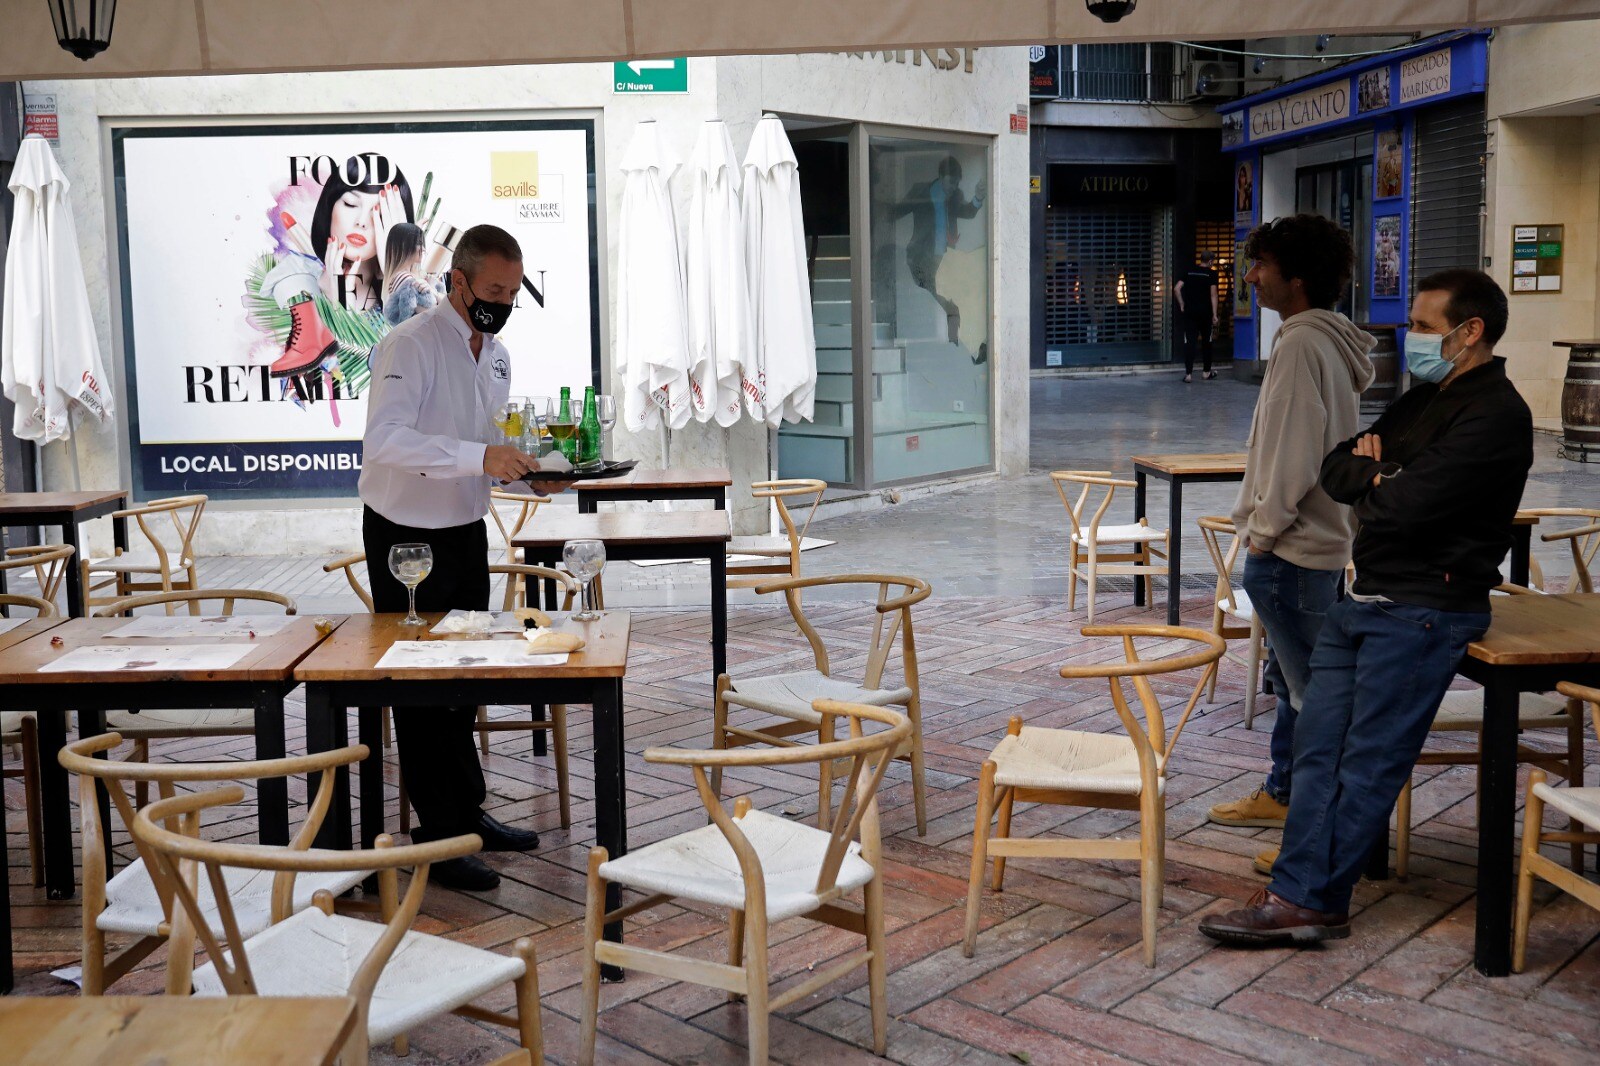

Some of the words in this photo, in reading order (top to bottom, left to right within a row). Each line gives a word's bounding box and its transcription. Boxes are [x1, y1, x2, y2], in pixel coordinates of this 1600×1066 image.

[1402, 51, 1449, 78] PESCADOS
[627, 82, 654, 91] Nueva
[1402, 75, 1449, 99] MARISCOS
[287, 154, 398, 187] FOOD
[494, 182, 537, 197] savills
[520, 203, 560, 211] AGUIRRE
[161, 455, 237, 474] LOCAL
[243, 453, 363, 472] DISPONIBL
